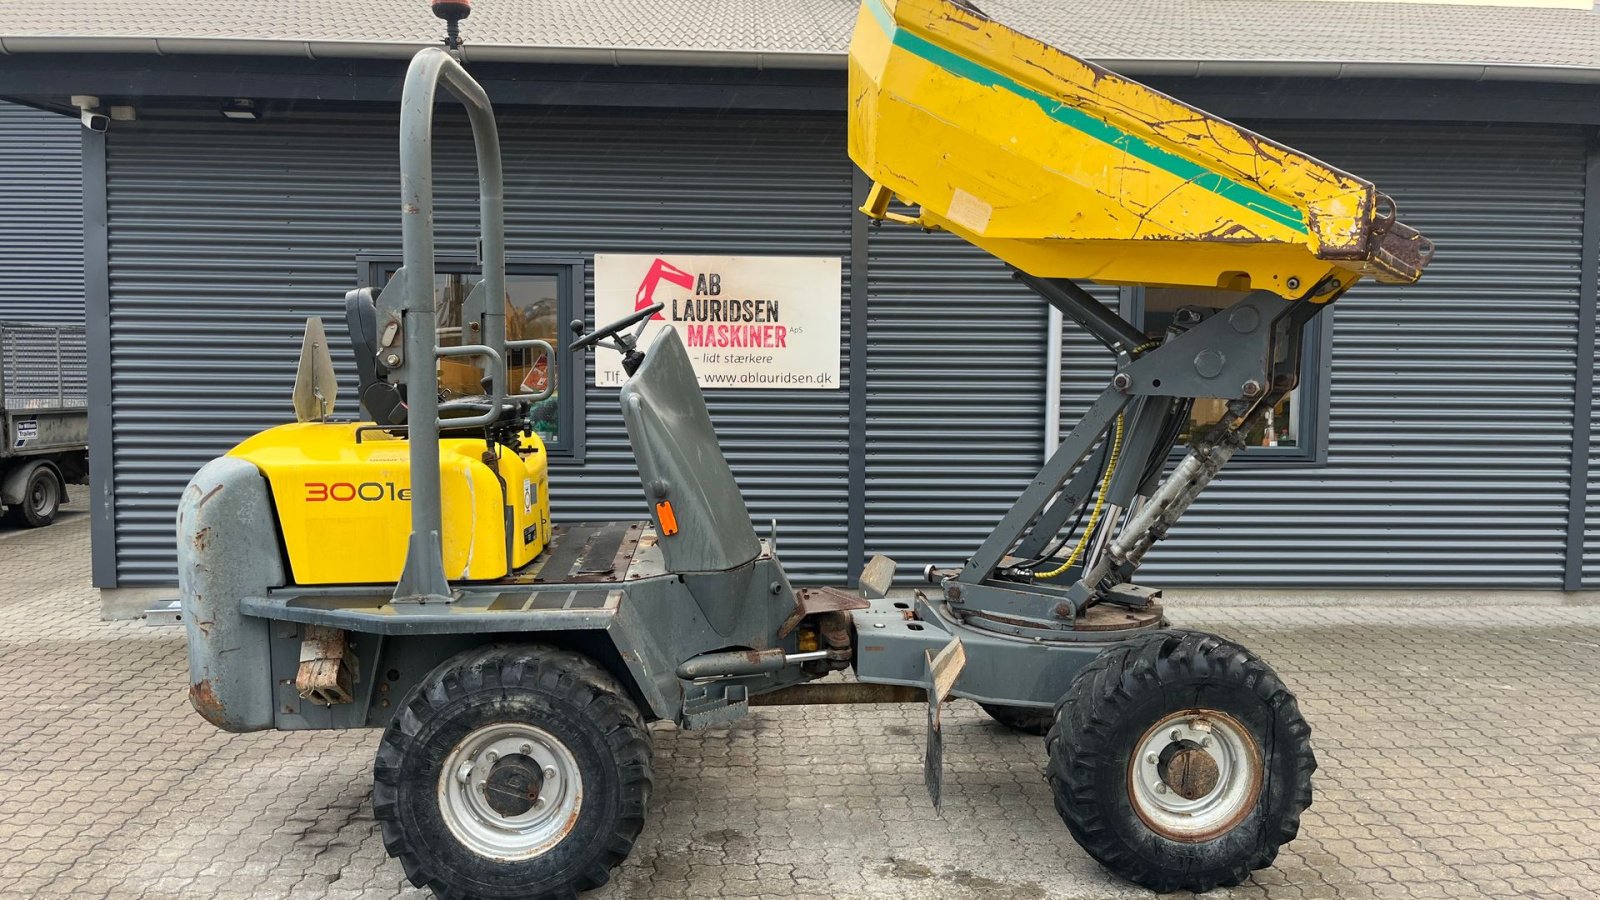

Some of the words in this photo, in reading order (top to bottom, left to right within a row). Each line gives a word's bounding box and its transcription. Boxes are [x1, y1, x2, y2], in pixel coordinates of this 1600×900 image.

[695, 273, 721, 296] AB
[672, 299, 779, 323] LAURIDSEN
[687, 325, 787, 348] MASKINER
[789, 326, 803, 334] ApS
[703, 353, 721, 363] lidt
[724, 353, 773, 364] stærkere
[604, 370, 624, 384] Tlf.
[704, 370, 832, 384] www.ablauridsen.dk
